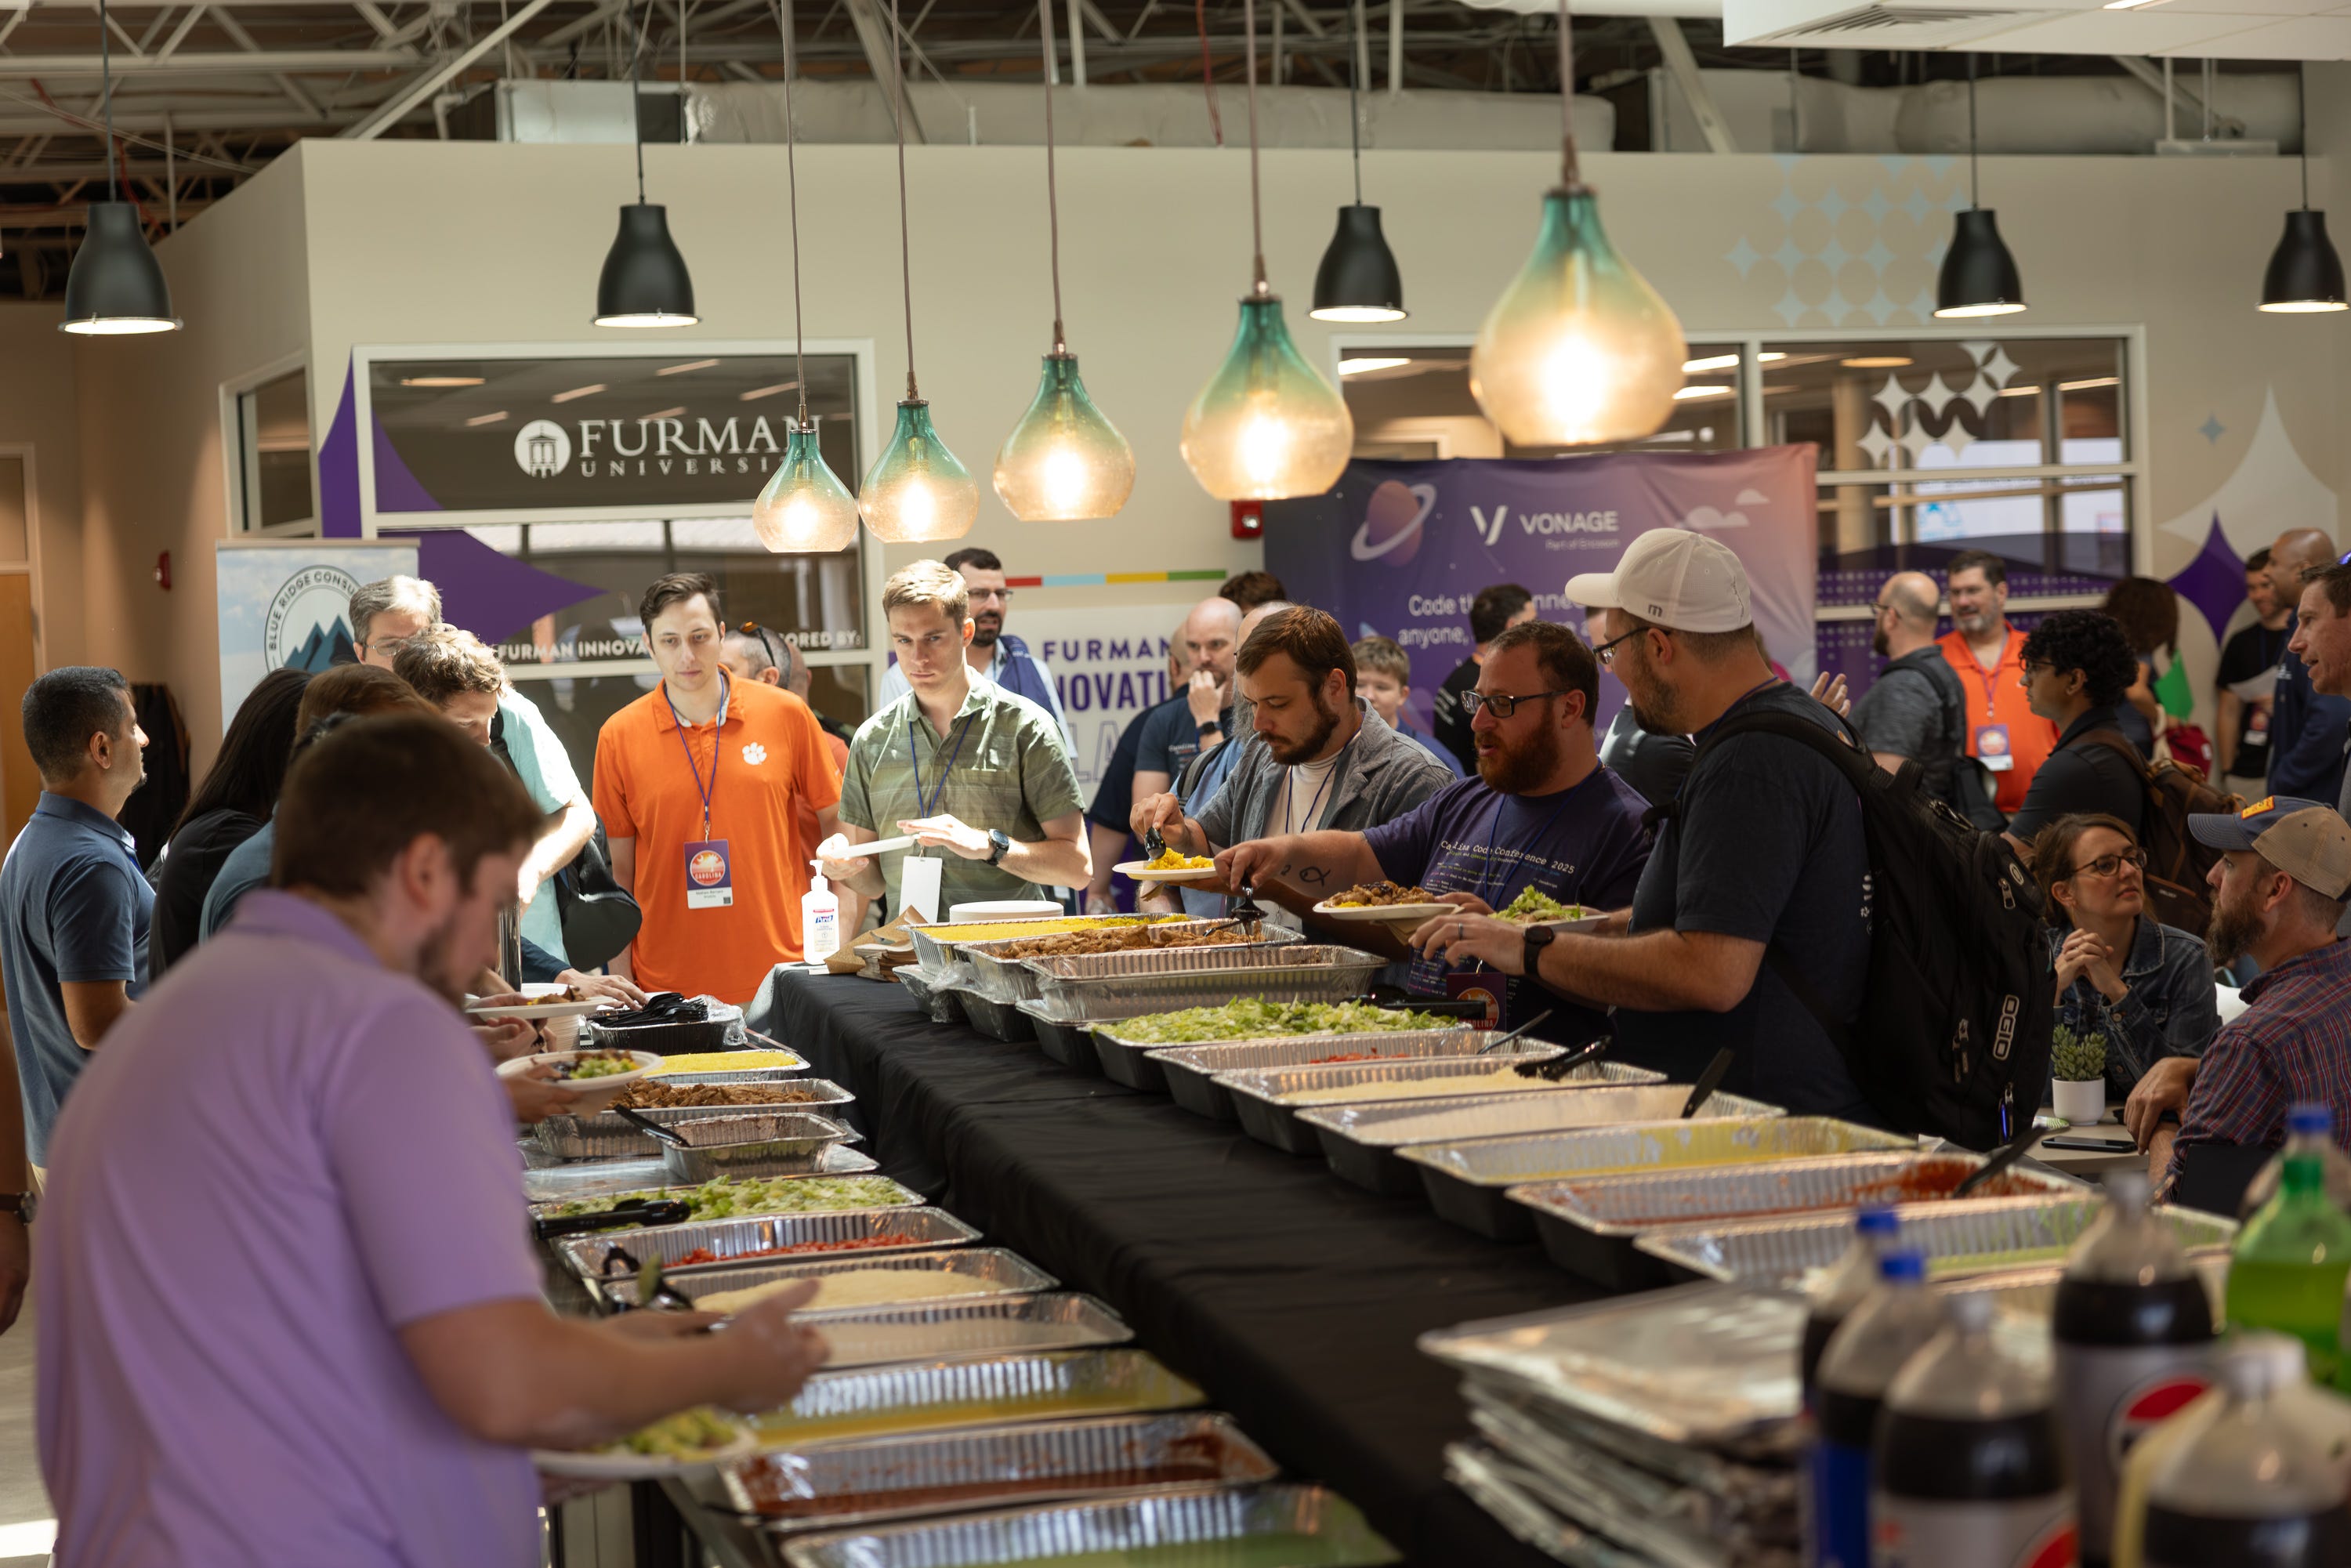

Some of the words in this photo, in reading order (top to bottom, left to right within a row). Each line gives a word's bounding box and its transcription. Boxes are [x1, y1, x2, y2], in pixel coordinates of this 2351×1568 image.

[578, 415, 824, 458] FURMAN
[581, 456, 787, 477] UNIVERSI
[1519, 510, 1620, 534] VONAGE
[269, 611, 281, 650] BLUE
[278, 574, 311, 608] RIDGE
[313, 570, 356, 596] CONSU
[1408, 594, 1457, 617] Code
[498, 642, 574, 661] FURMAN
[578, 639, 649, 657] INNOVA
[1043, 637, 1170, 662] FURMAN
[1397, 626, 1469, 650] anyone,
[1494, 846, 1547, 865] Conference
[1551, 860, 1575, 875] 2025
[1993, 994, 2020, 1060] OGIO
